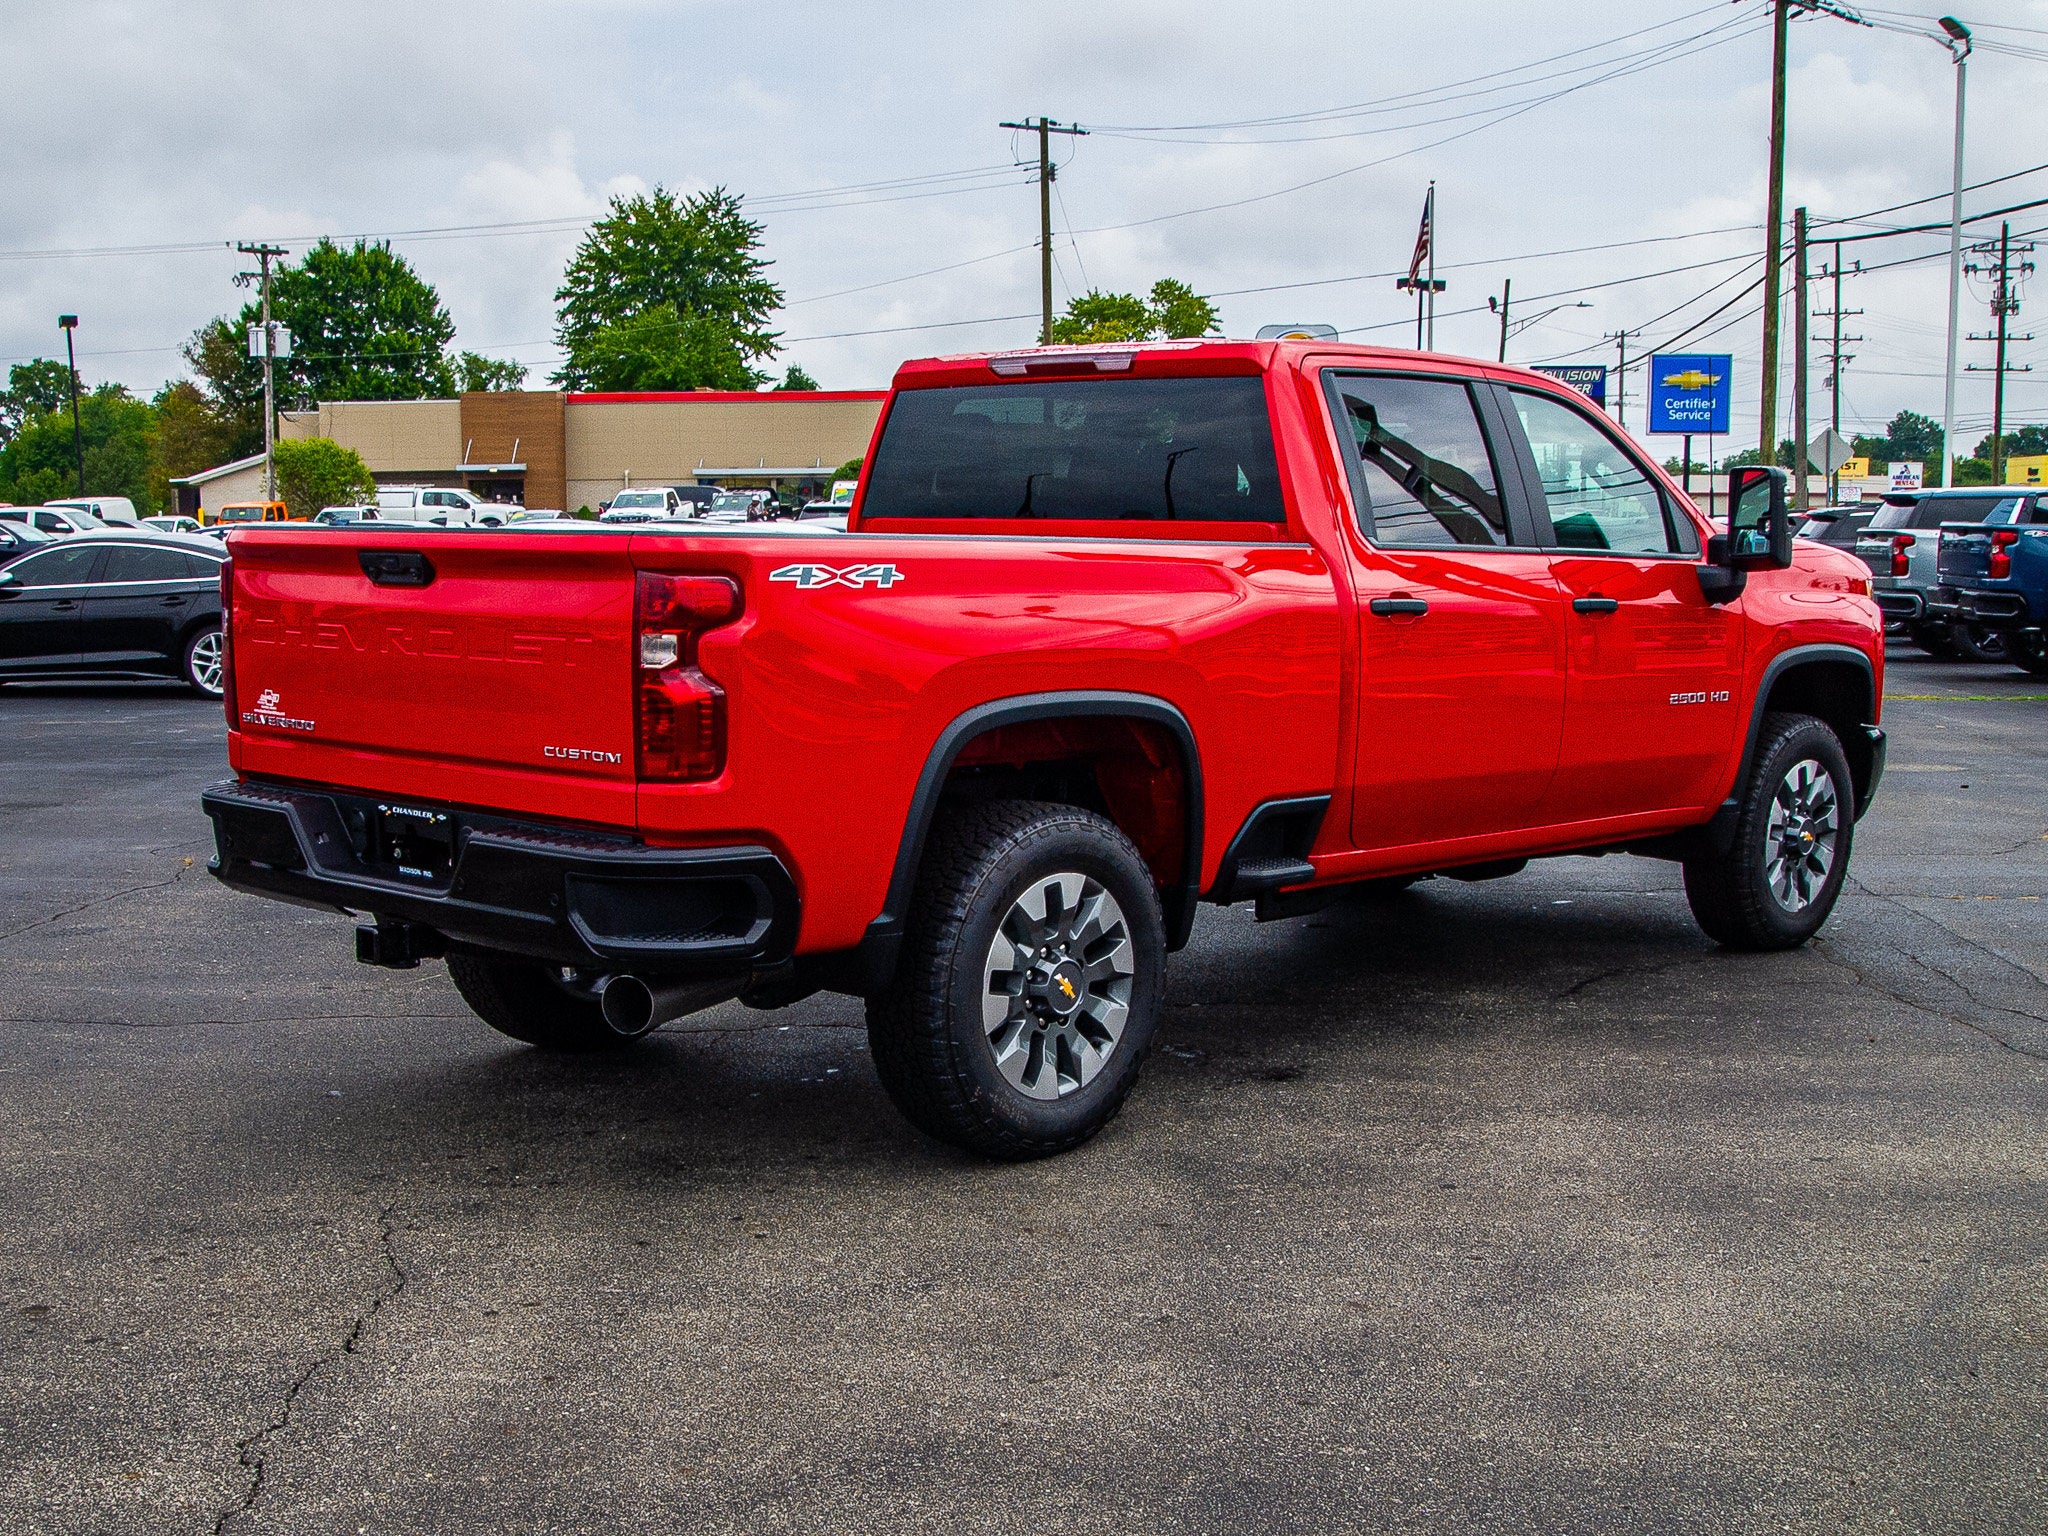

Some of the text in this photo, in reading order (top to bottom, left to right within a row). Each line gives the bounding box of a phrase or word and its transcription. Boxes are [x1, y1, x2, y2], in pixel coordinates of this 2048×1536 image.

[1665, 398, 1716, 409] Certified
[1668, 409, 1711, 420] Service
[251, 616, 595, 667] CHEVROLET
[1669, 690, 1730, 705] 2500 HD
[242, 712, 315, 730] SILVERADO
[543, 745, 622, 764] CUSTOM
[392, 806, 433, 819] CHANDLER
